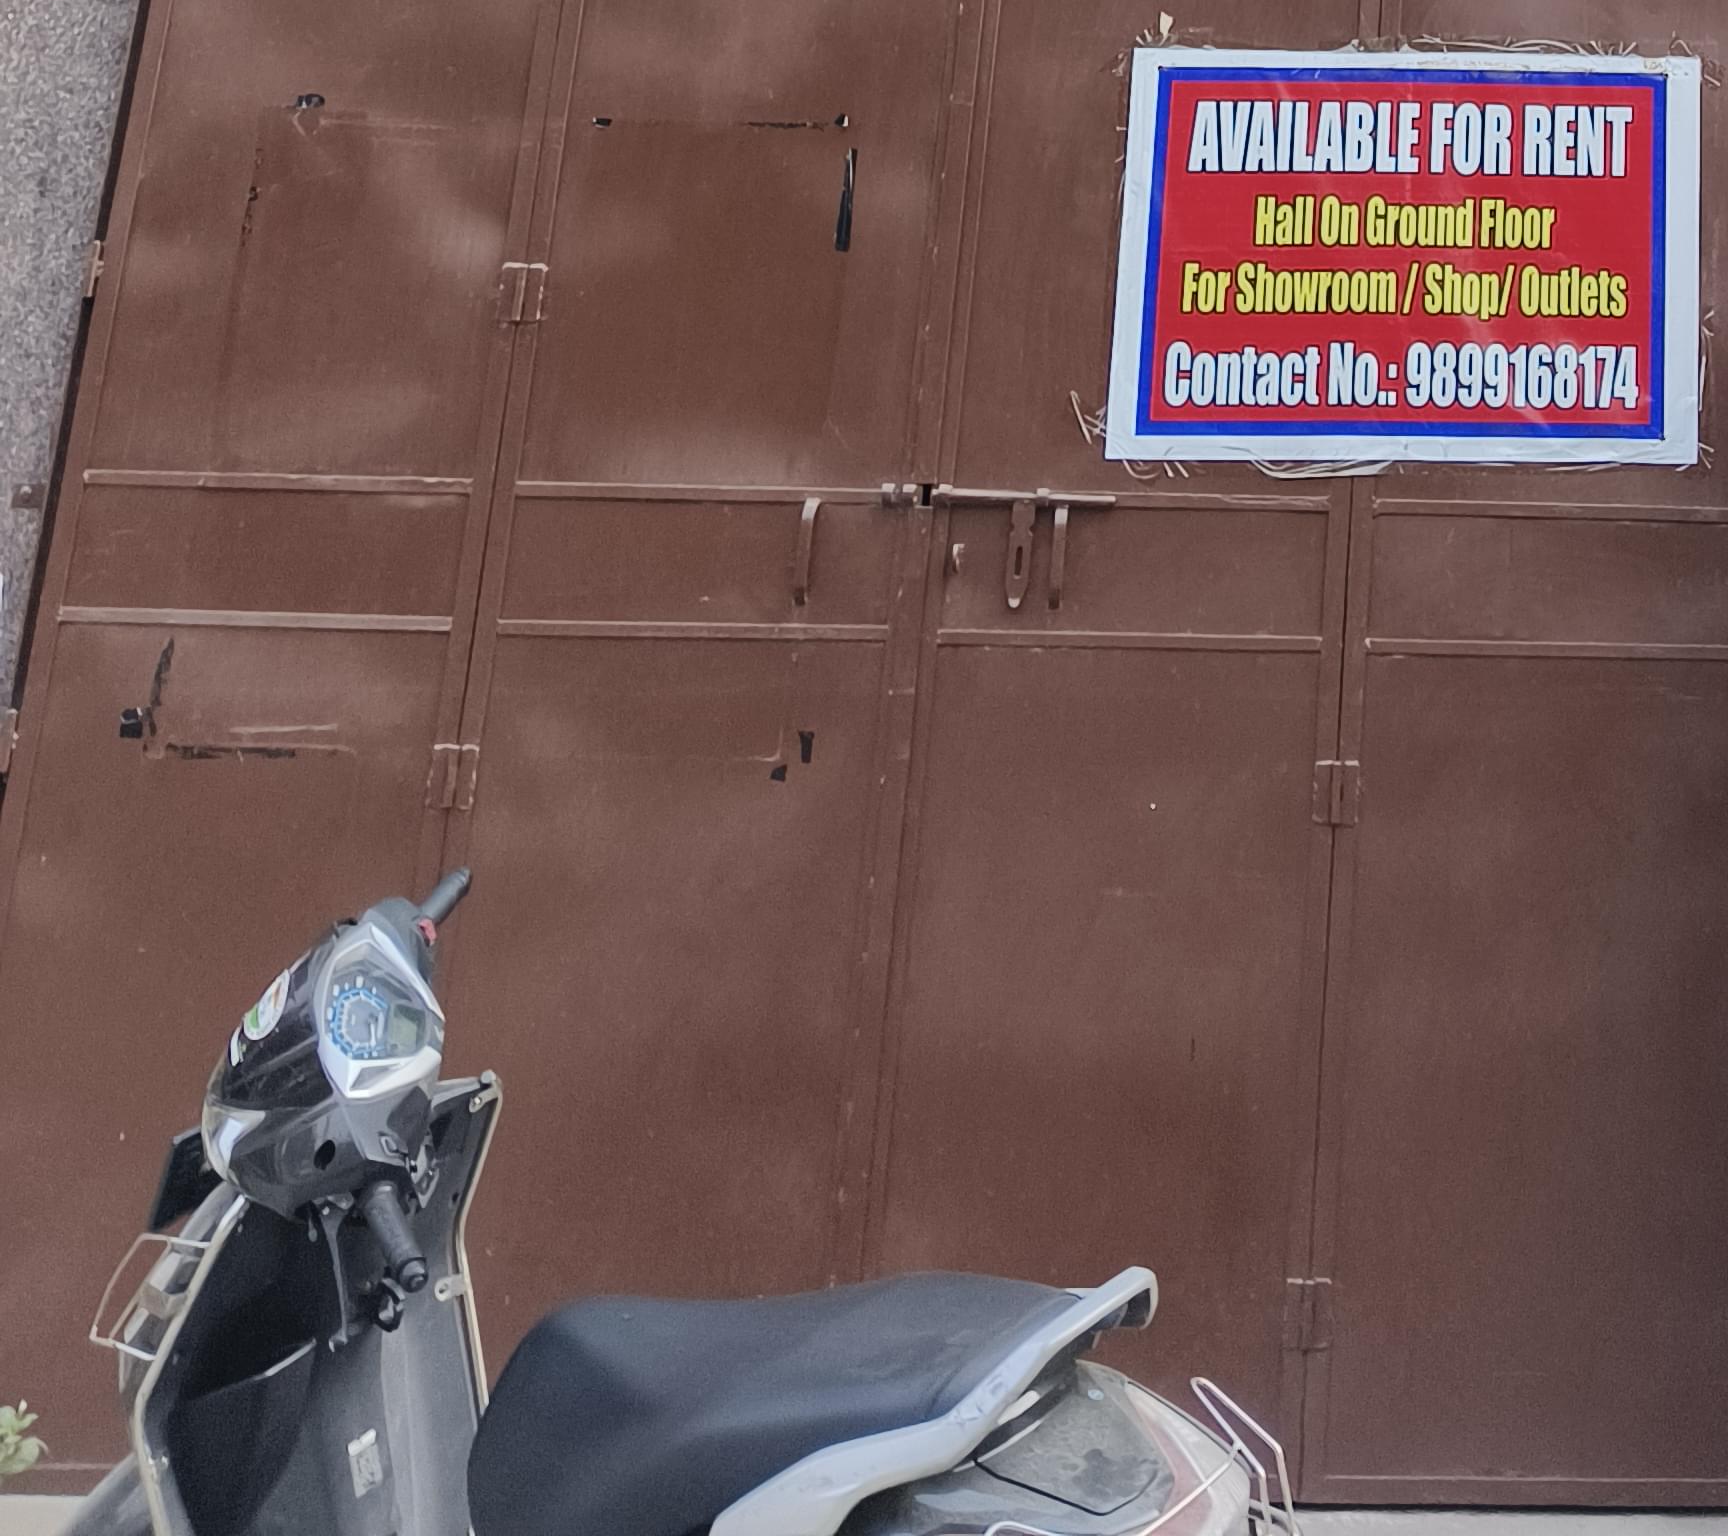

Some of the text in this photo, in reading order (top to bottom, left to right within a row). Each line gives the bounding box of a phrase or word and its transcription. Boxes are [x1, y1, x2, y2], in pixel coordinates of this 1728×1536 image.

[1187, 100, 1634, 177] AVAILABLE FOR RENT
[1253, 195, 1556, 249] Hall On Ground Floor
[1181, 262, 1231, 313] For
[1235, 263, 1397, 314] Showroom
[1519, 266, 1628, 317] Outlets
[1164, 341, 1320, 409] Contact
[1404, 343, 1640, 410] 9899168174
